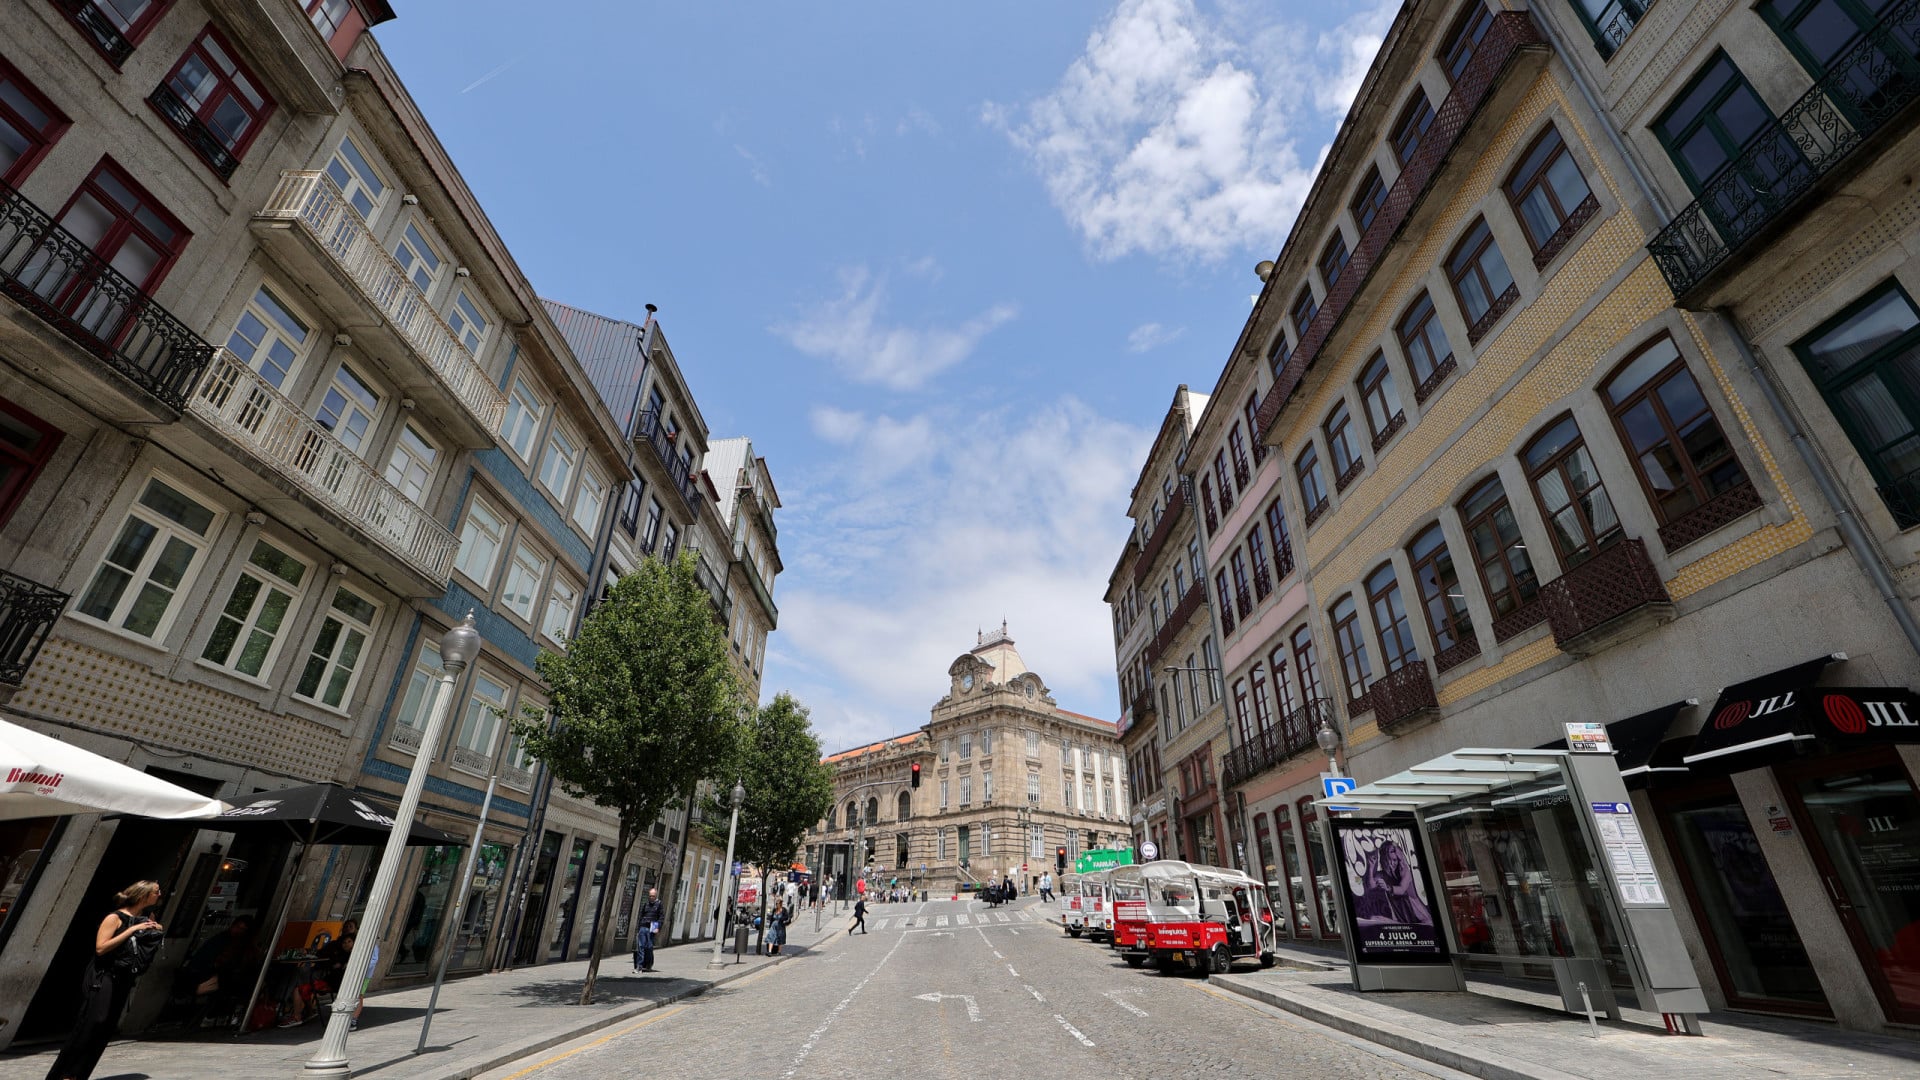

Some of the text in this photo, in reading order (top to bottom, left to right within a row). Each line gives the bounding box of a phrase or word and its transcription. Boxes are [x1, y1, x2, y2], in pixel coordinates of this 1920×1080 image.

[1749, 691, 1795, 719] JLL
[1862, 701, 1919, 727] JLL
[1867, 815, 1899, 833] JLL
[1379, 931, 1417, 940] 4 JULHO
